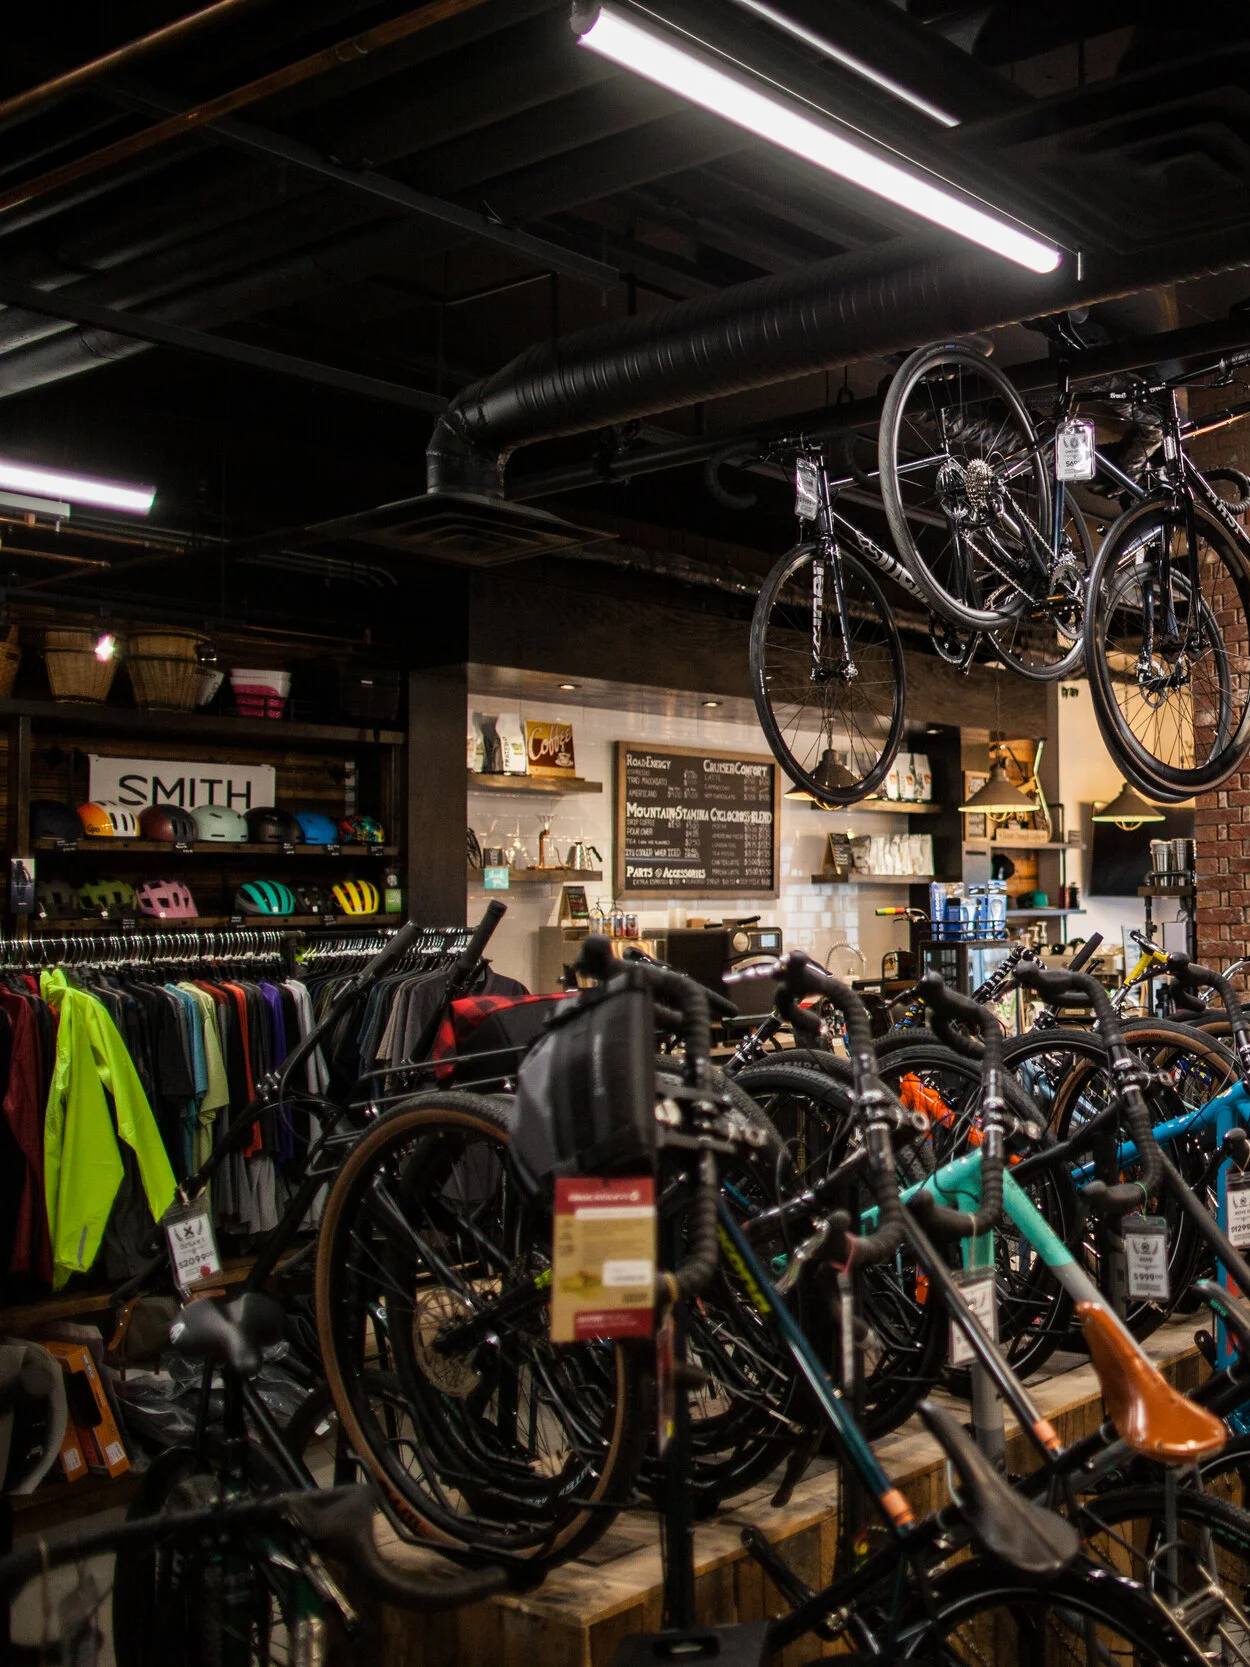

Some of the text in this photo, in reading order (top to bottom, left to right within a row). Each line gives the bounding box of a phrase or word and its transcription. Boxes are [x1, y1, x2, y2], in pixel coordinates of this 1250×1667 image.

[528, 726, 573, 761] Coffee
[118, 774, 251, 809] SMITH
[626, 865, 706, 879] PARTS ACCESSORIES
